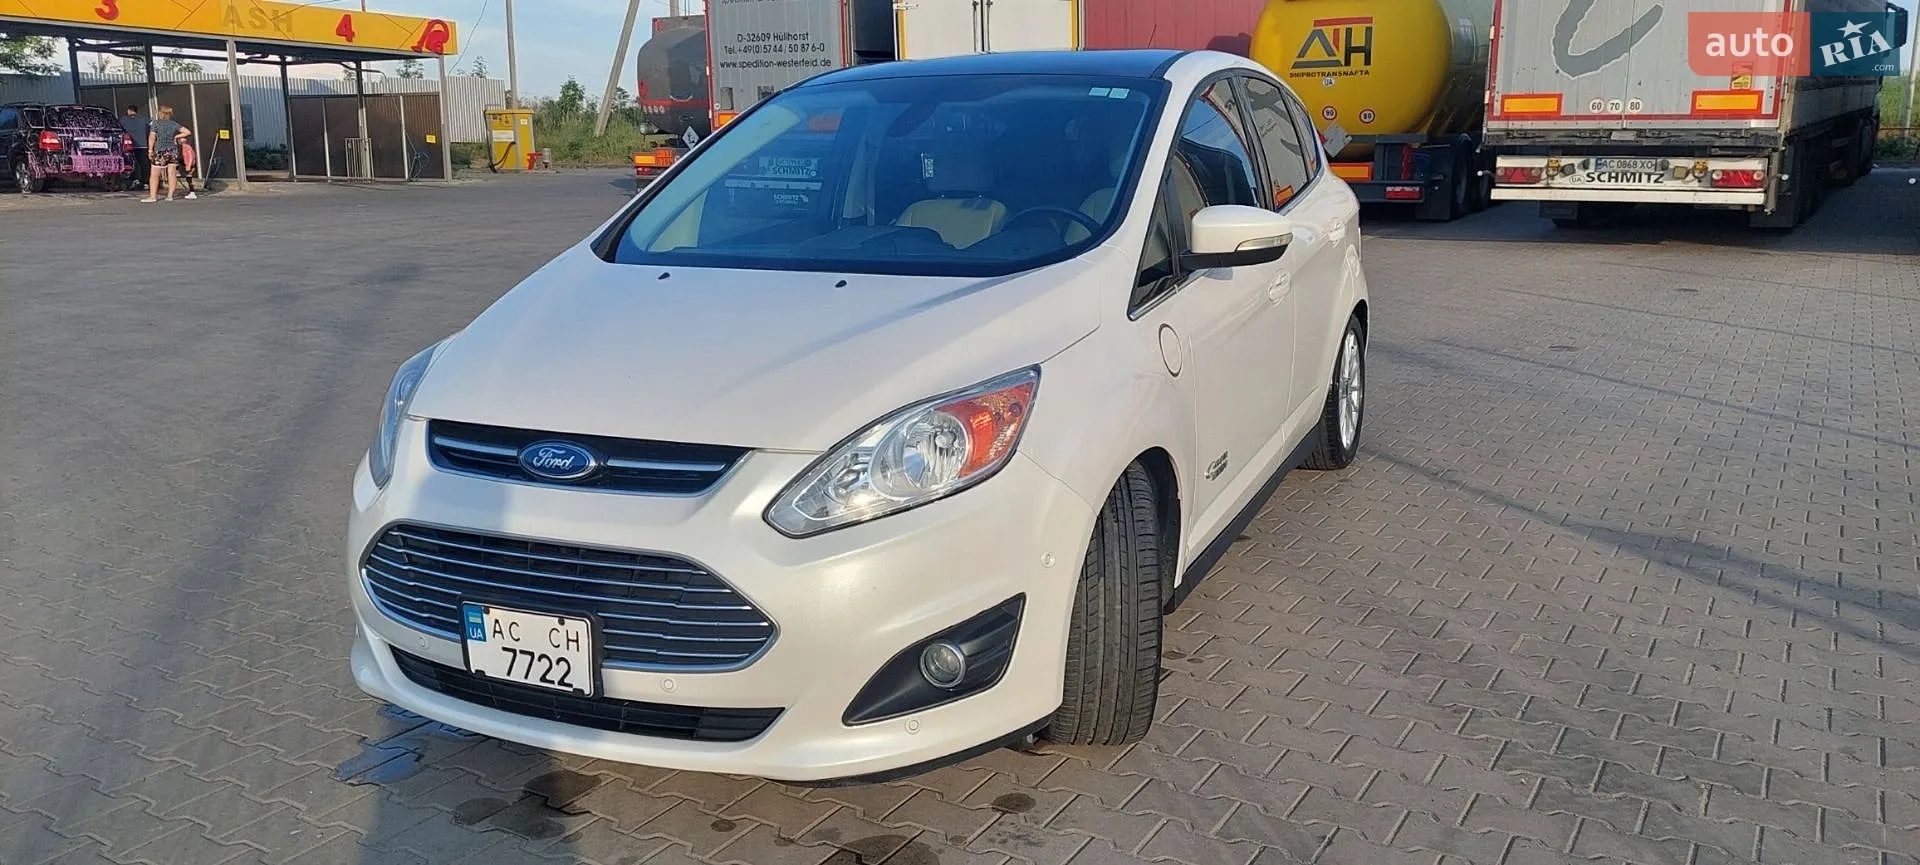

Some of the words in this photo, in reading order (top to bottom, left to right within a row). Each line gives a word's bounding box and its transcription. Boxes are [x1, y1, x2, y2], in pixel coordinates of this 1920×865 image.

[94, 0, 120, 21] 3
[335, 14, 355, 43] 4
[737, 32, 771, 42] D-32609
[773, 31, 809, 41] Hüllhorst
[1591, 102, 1602, 111] 60
[1609, 102, 1620, 111] 70
[1629, 101, 1640, 111] 80
[1603, 159, 1615, 169] AC
[1586, 171, 1665, 184] SCHMITZ
[532, 447, 576, 470] Ford
[469, 627, 484, 640] UA
[492, 618, 521, 642] AC
[548, 627, 580, 652] CH
[501, 646, 574, 688] 7722
